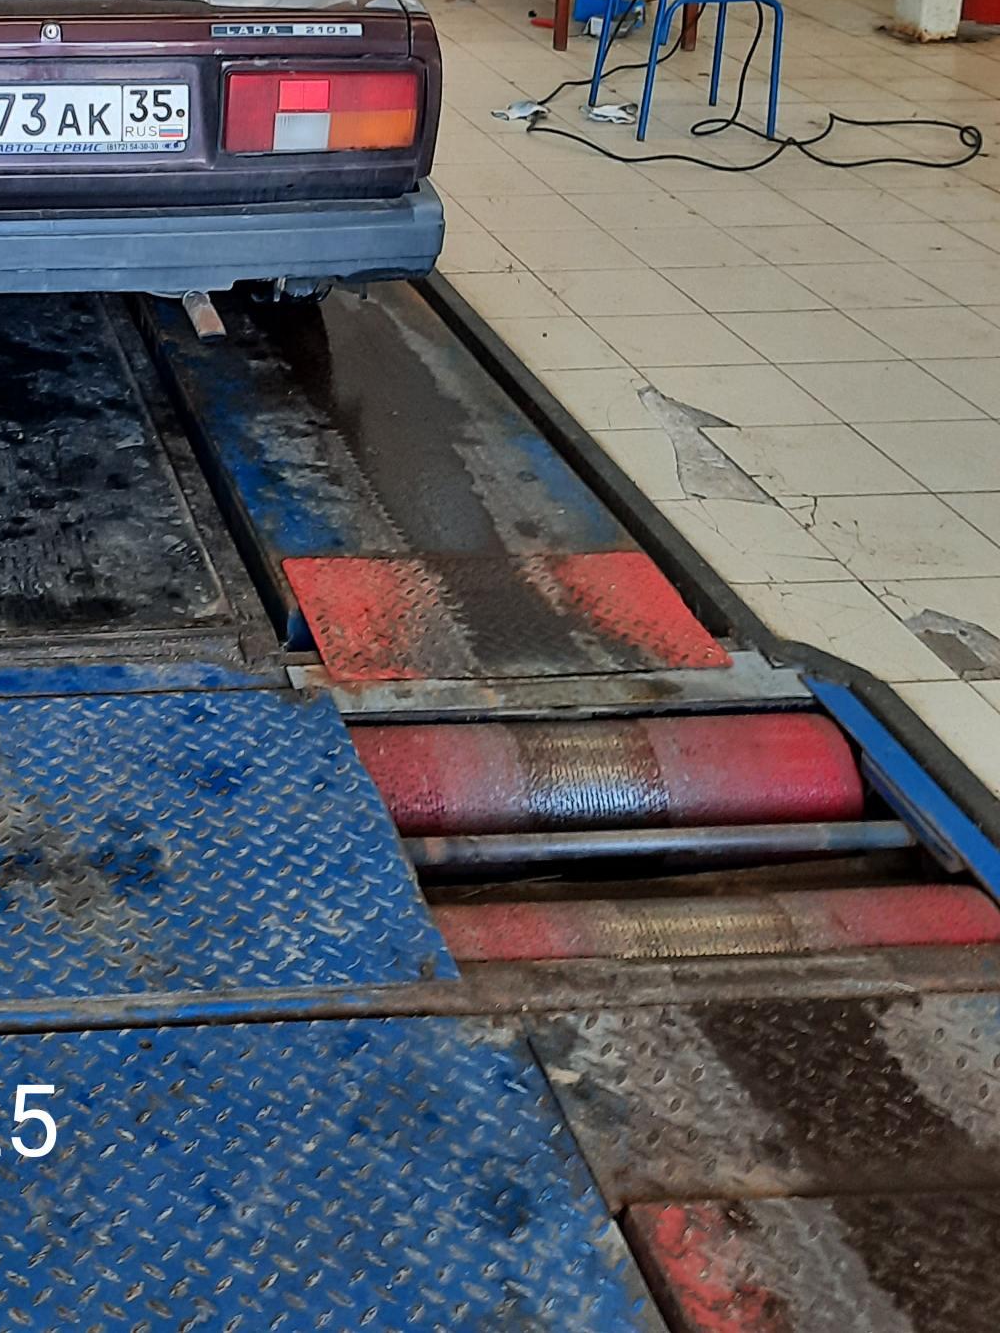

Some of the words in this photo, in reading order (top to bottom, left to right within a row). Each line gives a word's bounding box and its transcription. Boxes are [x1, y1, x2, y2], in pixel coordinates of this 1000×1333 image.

[226, 26, 277, 35] LADA
[305, 26, 348, 34] 2105
[130, 89, 172, 122] 35
[125, 126, 158, 137] RUS
[107, 141, 128, 151] (8172)
